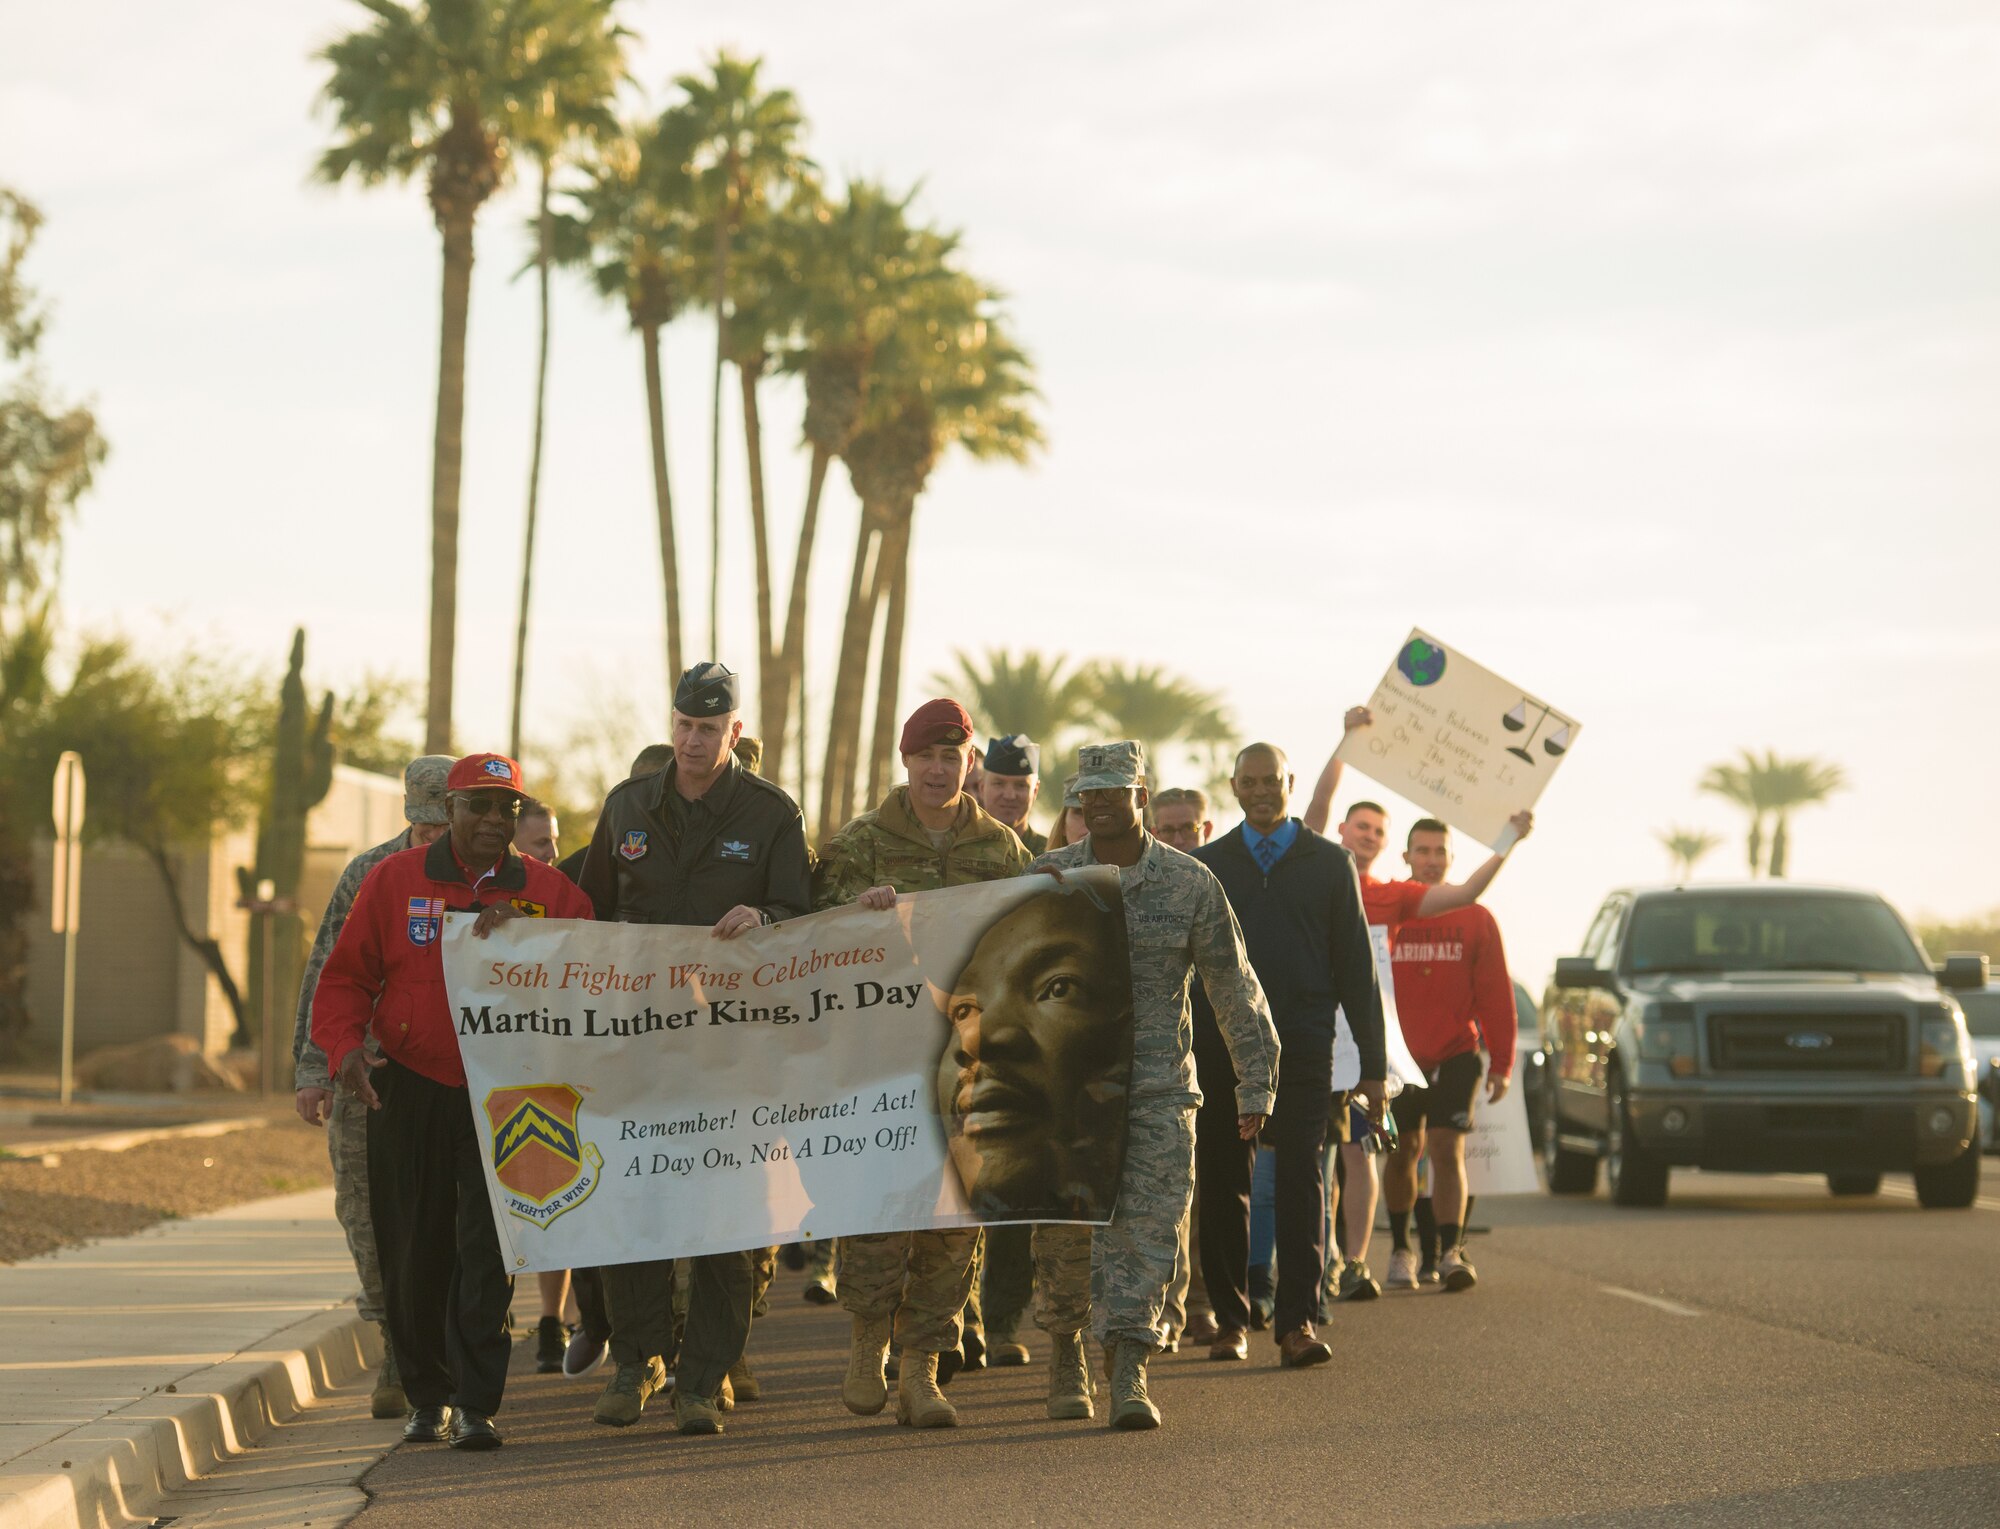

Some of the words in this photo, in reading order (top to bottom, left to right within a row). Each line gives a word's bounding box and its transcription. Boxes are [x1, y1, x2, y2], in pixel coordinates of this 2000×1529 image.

[1372, 690, 1399, 717] That
[1406, 711, 1425, 734] The
[1434, 726, 1486, 769] Universe
[1496, 762, 1516, 787] Is
[1393, 724, 1411, 746] On
[1425, 743, 1446, 767] The
[1454, 759, 1480, 786] Side
[1369, 736, 1394, 760] Of
[1407, 759, 1464, 805] Justice
[488, 962, 549, 989] 56th
[557, 962, 657, 996] Fighter
[667, 963, 744, 991] Wing
[752, 947, 886, 987] Celebrates
[1391, 941, 1464, 962] ARDINALS
[459, 1005, 573, 1037] Martin
[583, 1006, 699, 1037] Luther
[708, 1000, 800, 1026] King,
[808, 988, 845, 1023] Jr.
[854, 981, 923, 1009] Day
[618, 1109, 737, 1141] Remember!
[752, 1096, 858, 1127] Celebrate!
[871, 1089, 917, 1113] Act!
[624, 1155, 643, 1177] A
[650, 1153, 695, 1176] Day
[703, 1147, 742, 1170] On,
[750, 1142, 790, 1164] Not
[795, 1138, 814, 1159] A
[821, 1135, 867, 1156] Day
[874, 1126, 918, 1151] Off!
[510, 1198, 563, 1218] FIGHTER
[562, 1177, 591, 1203] WING
